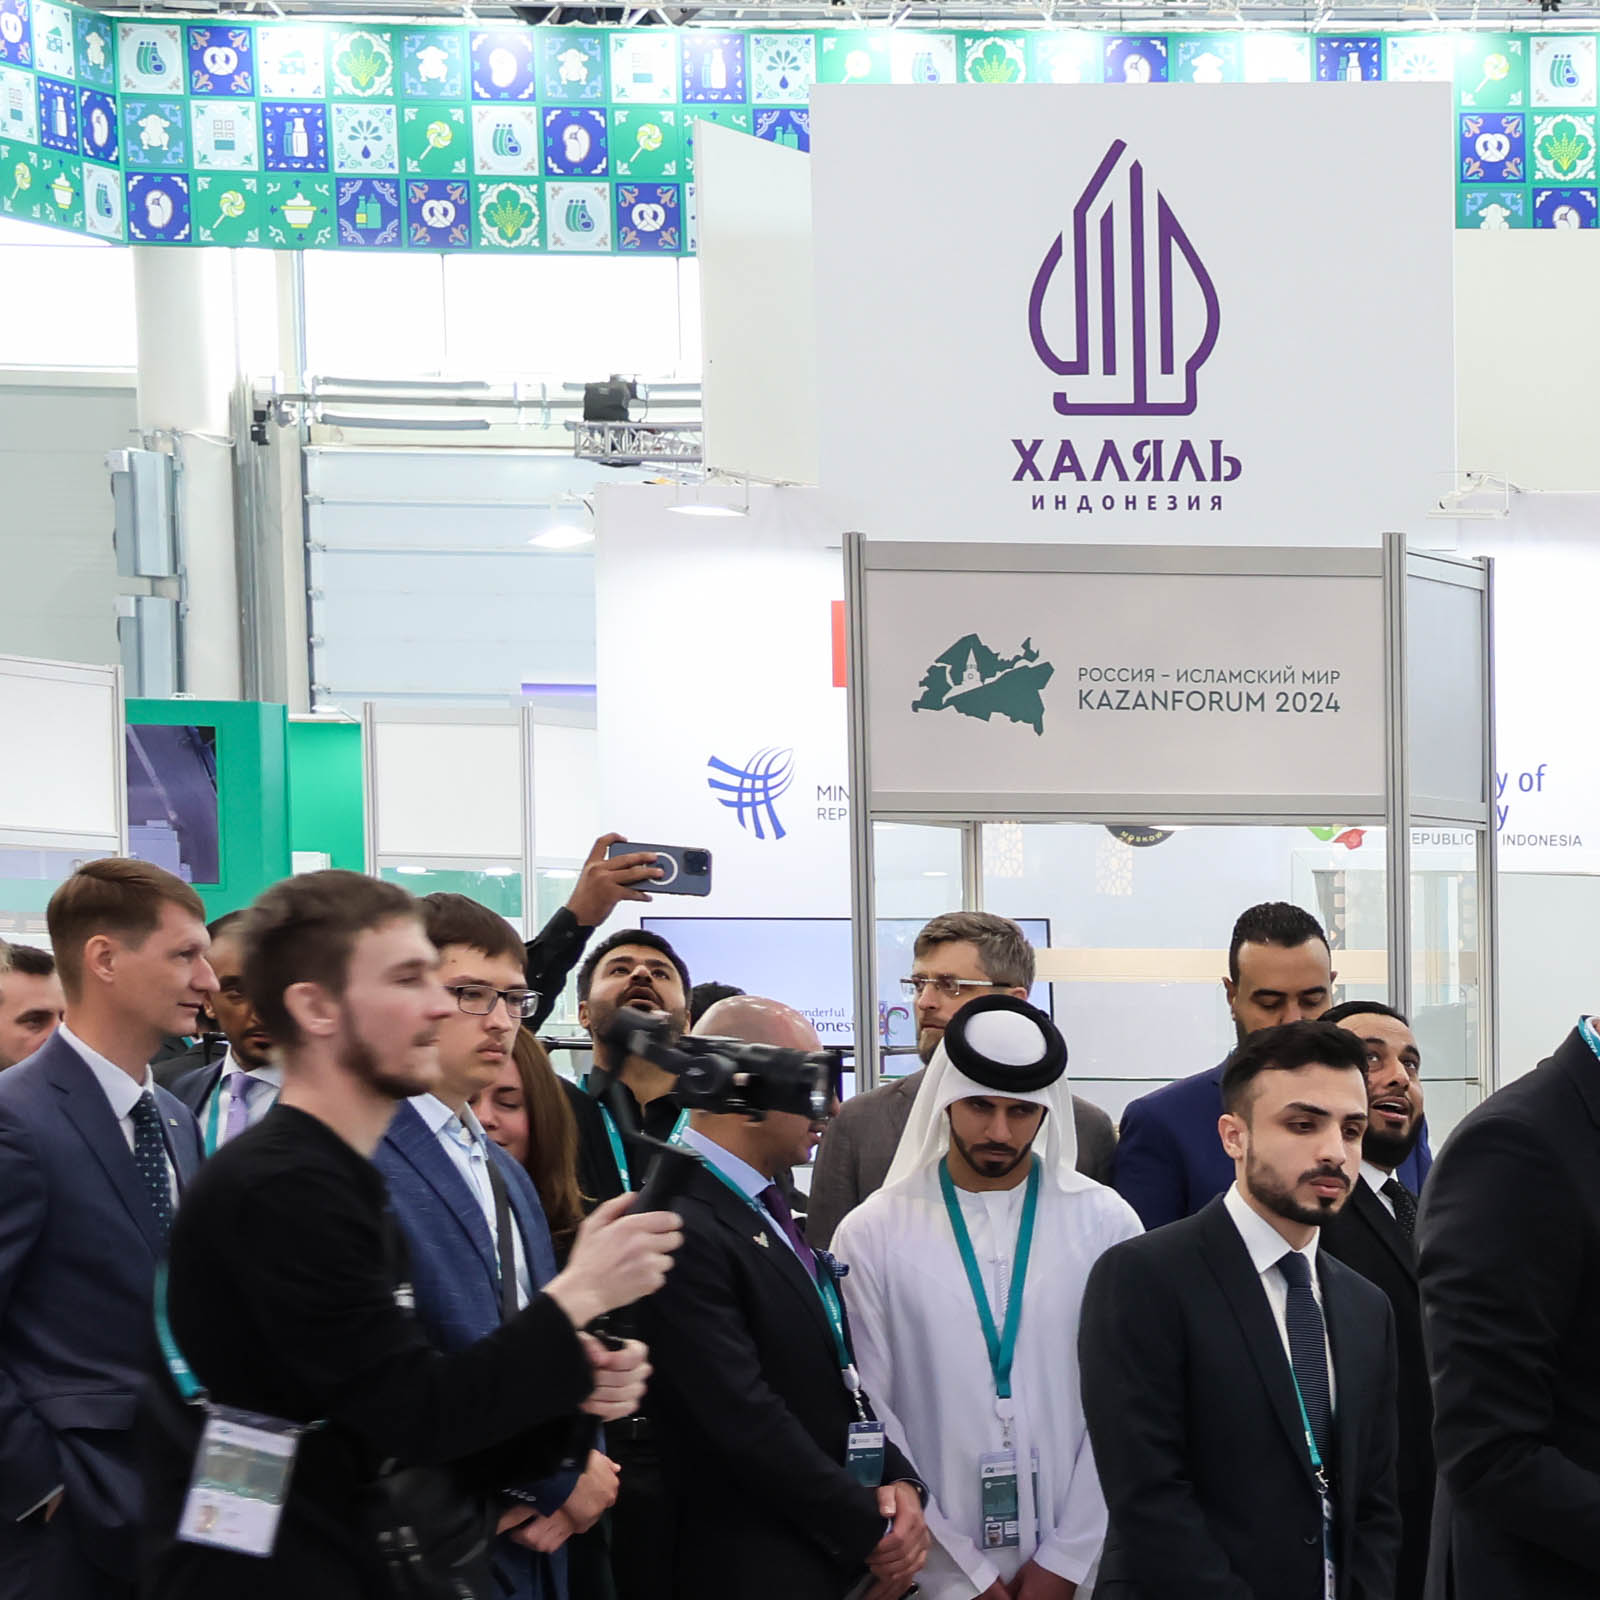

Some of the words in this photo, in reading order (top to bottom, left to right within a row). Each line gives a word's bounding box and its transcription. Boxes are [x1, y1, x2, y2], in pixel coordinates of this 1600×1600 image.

[1010, 438, 1243, 483] ХАЛЯЛЬ
[1031, 494, 1223, 514] ИНДОНЕЗИЯ
[1078, 668, 1155, 683] РОССИЯ
[1176, 666, 1295, 684] ИСЛАМСКИЙ
[1302, 670, 1341, 685] МИР
[1078, 689, 1265, 713] KAZANFORUM
[1275, 691, 1341, 713] 2024
[1518, 764, 1548, 792] of
[1412, 832, 1475, 846] EPUBLIC
[1502, 834, 1583, 847] INDONESIA
[800, 1007, 845, 1018] onderful
